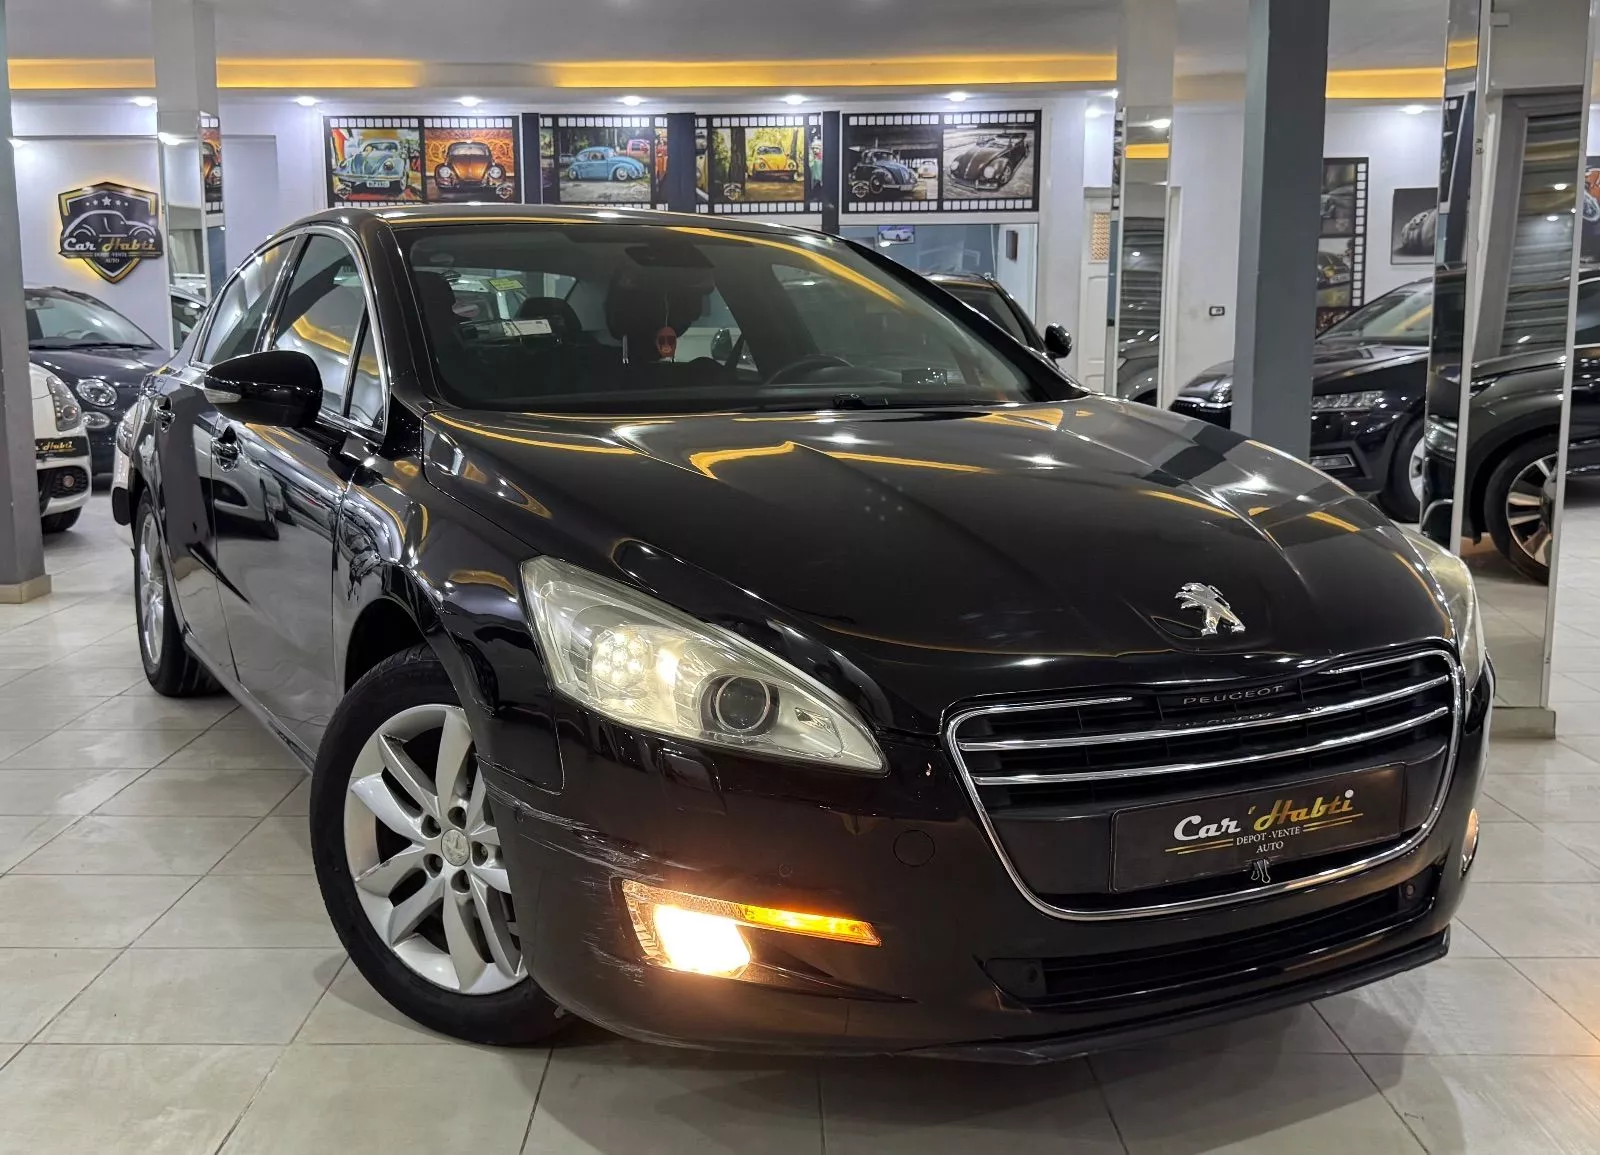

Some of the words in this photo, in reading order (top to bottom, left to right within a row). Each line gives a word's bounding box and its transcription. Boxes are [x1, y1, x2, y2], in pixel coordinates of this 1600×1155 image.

[63, 237, 96, 251] Car
[1183, 685, 1284, 705] PEUGEOT
[1173, 815, 1241, 841] Car
[1236, 832, 1267, 846] DEPOT
[1256, 840, 1284, 853] AUTO
